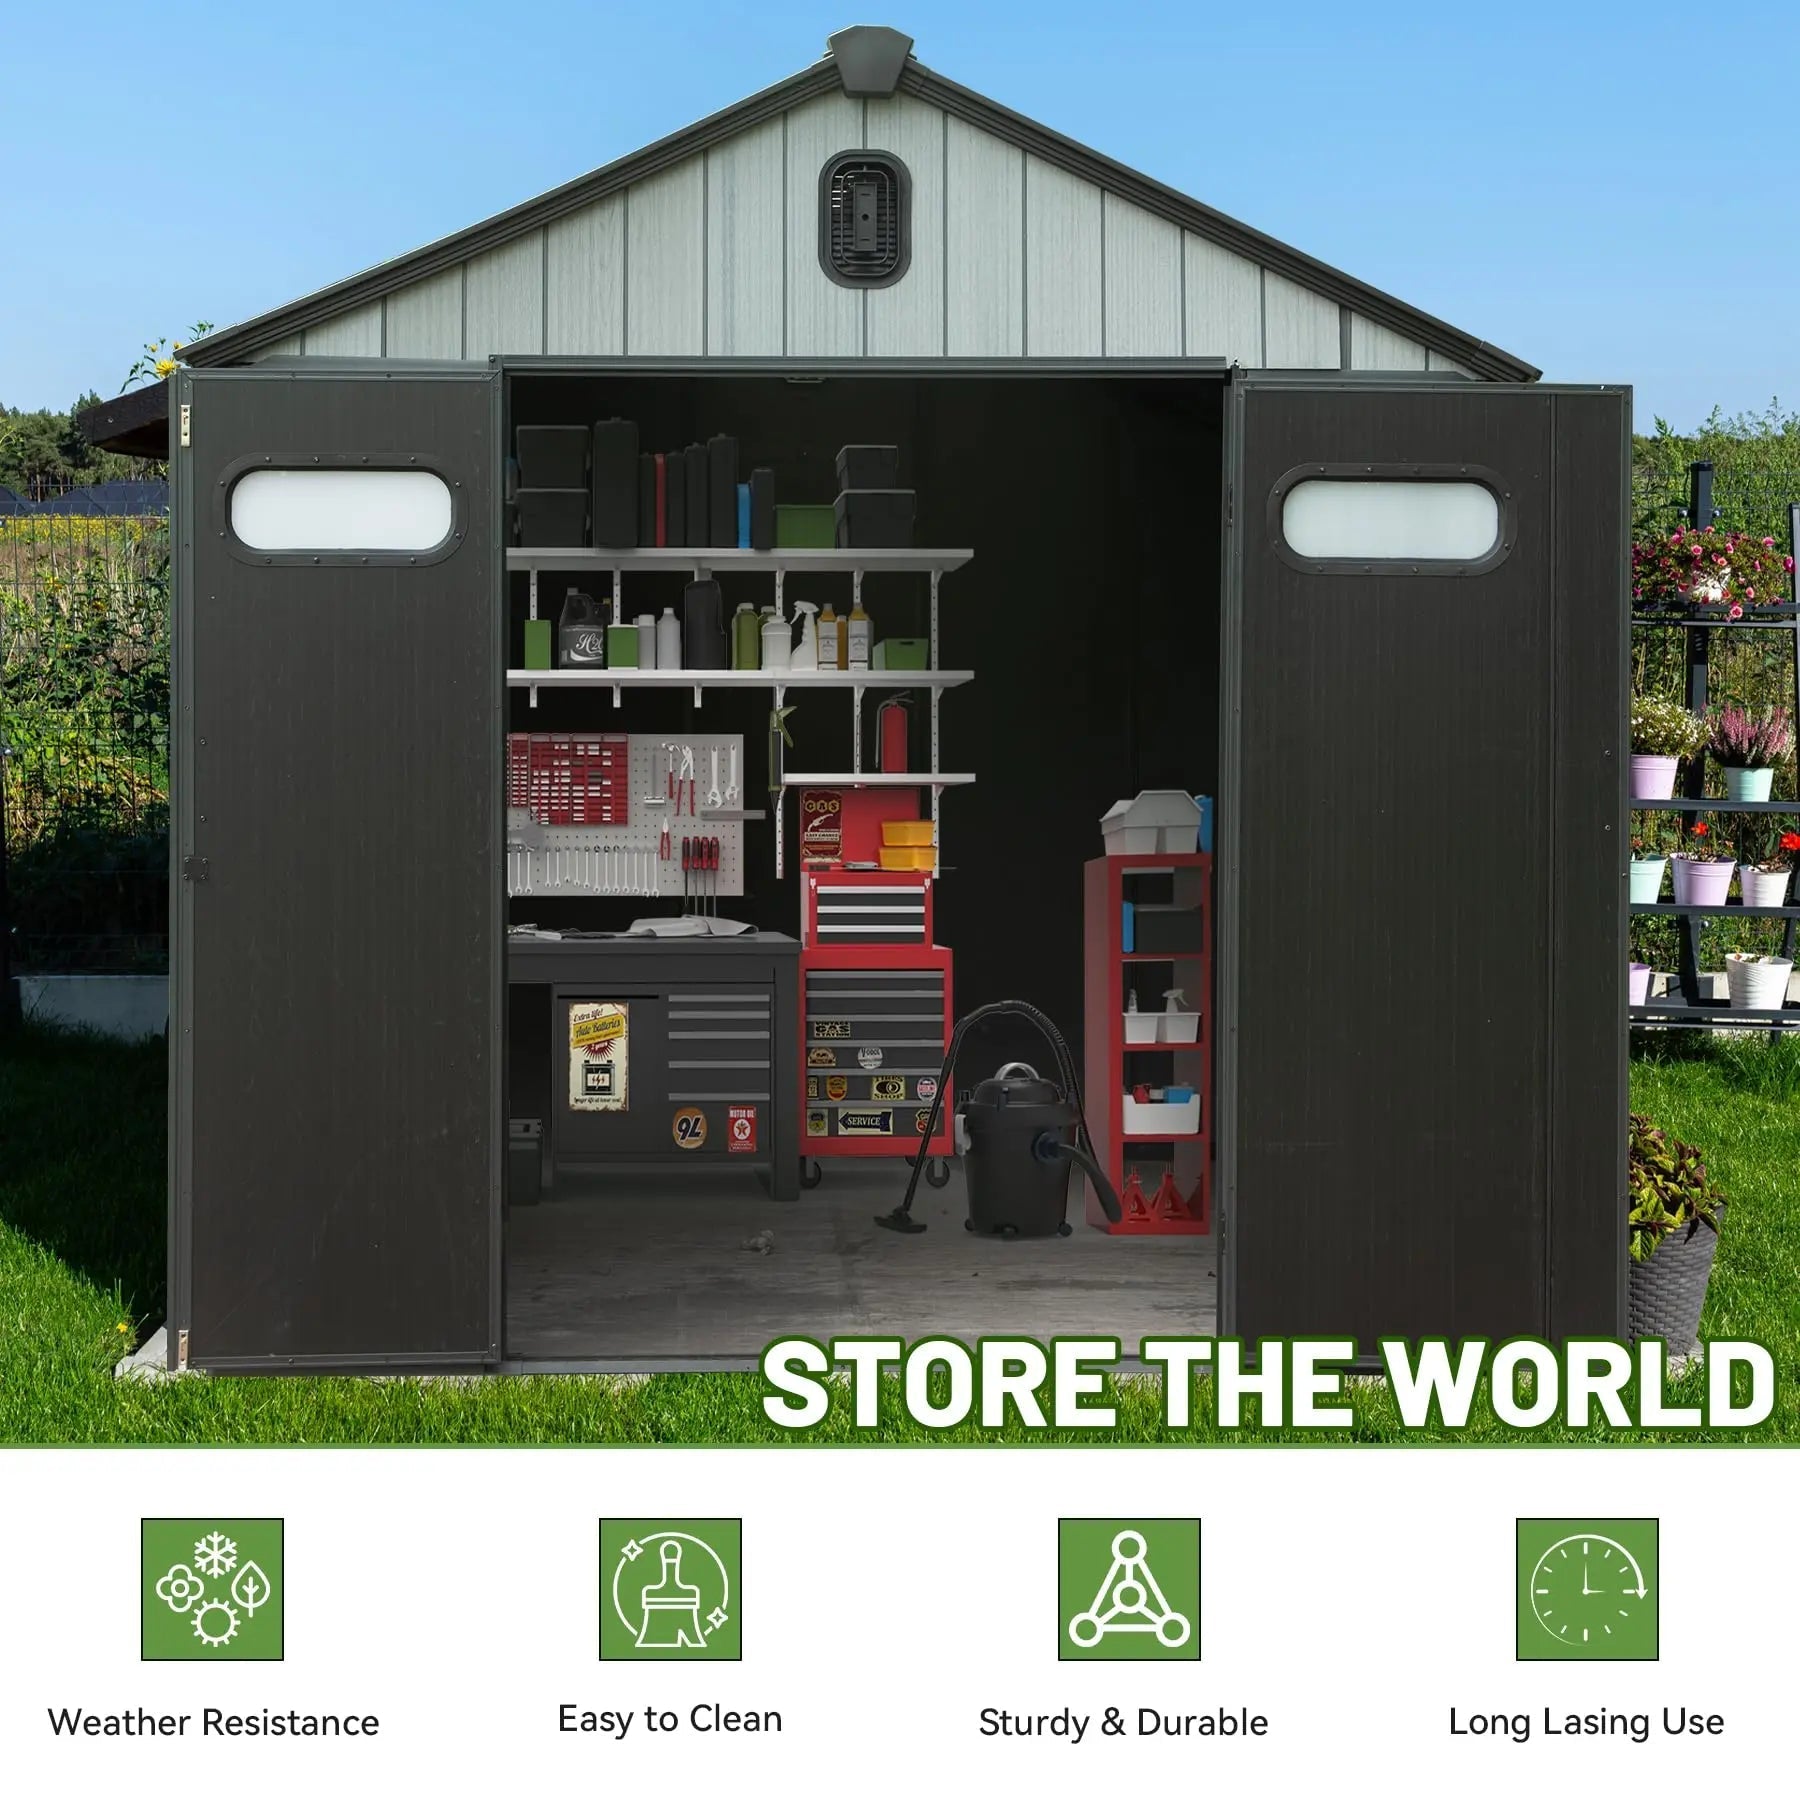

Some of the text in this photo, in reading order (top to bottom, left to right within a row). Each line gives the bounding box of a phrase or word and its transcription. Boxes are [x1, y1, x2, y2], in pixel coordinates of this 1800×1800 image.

[574, 1012, 590, 1022] Extra
[592, 1018, 621, 1033] Batteries
[815, 1025, 850, 1033] GAS
[729, 1109, 755, 1118] MOTOR OIL
[847, 1115, 881, 1127] SERVICE
